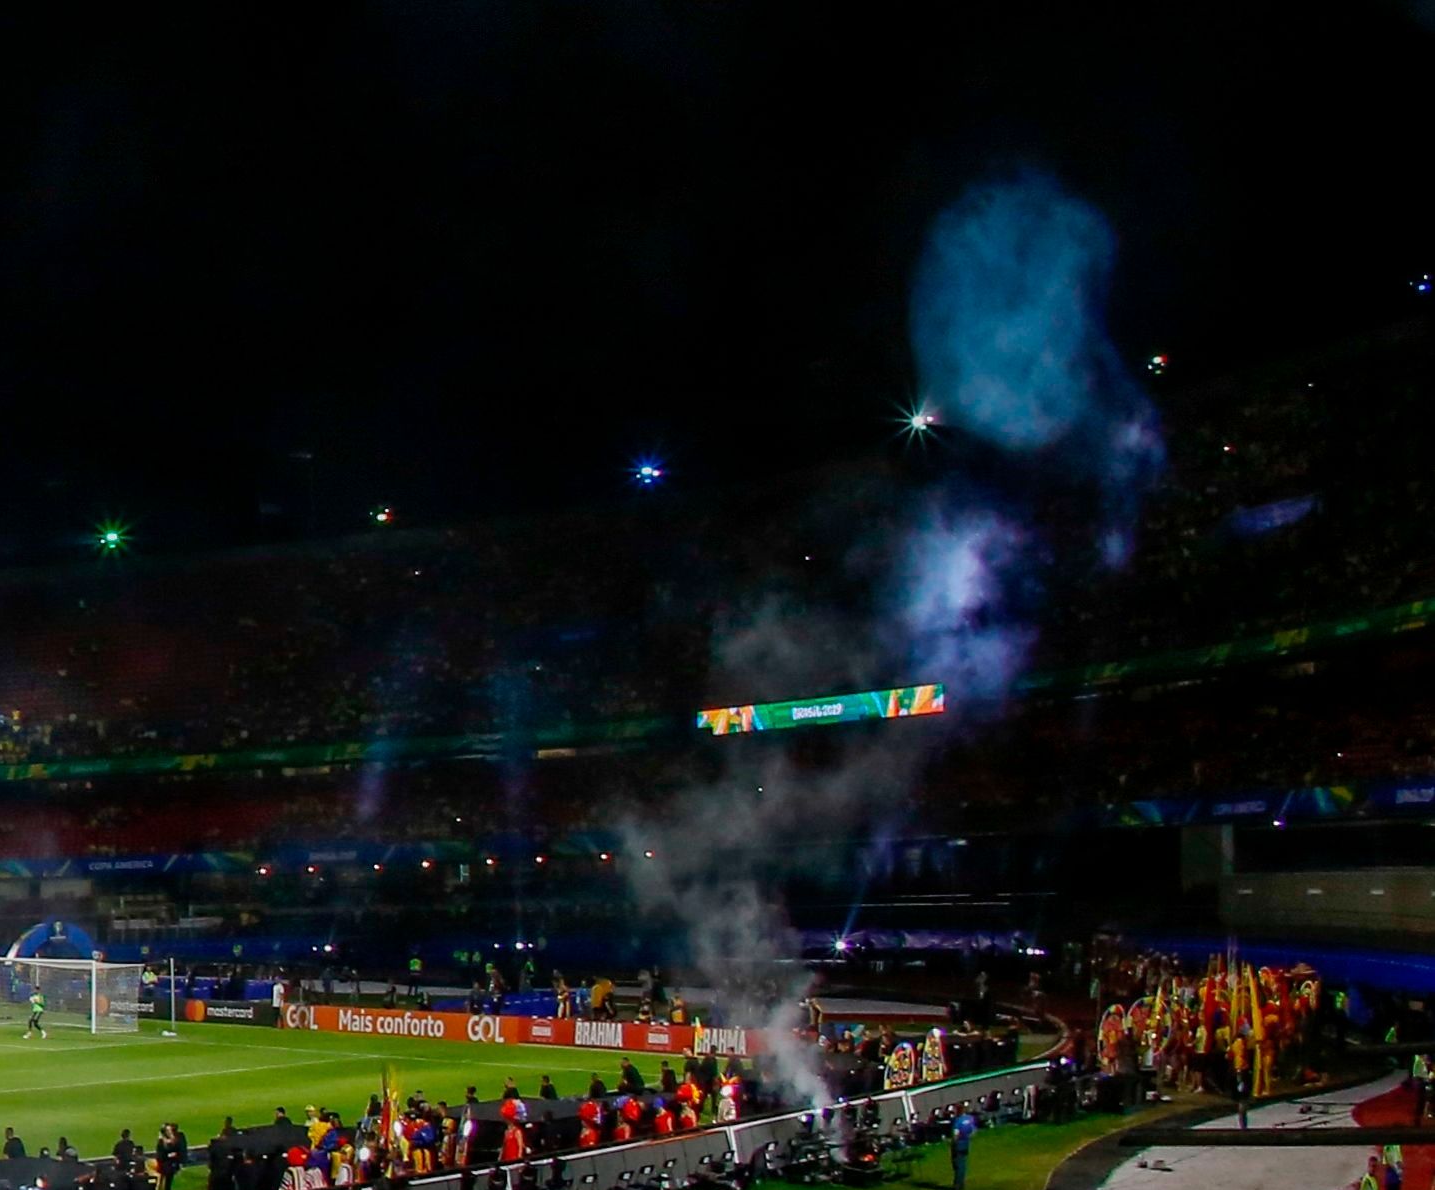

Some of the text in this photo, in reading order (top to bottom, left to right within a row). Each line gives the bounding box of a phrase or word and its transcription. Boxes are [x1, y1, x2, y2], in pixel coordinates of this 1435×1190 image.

[207, 1005, 254, 1019] mastercard
[285, 1004, 318, 1031] GOL
[338, 1008, 372, 1033] Mais
[375, 1011, 445, 1038] conforto
[467, 1014, 505, 1043] GOL
[574, 1018, 623, 1048] BRAHMA
